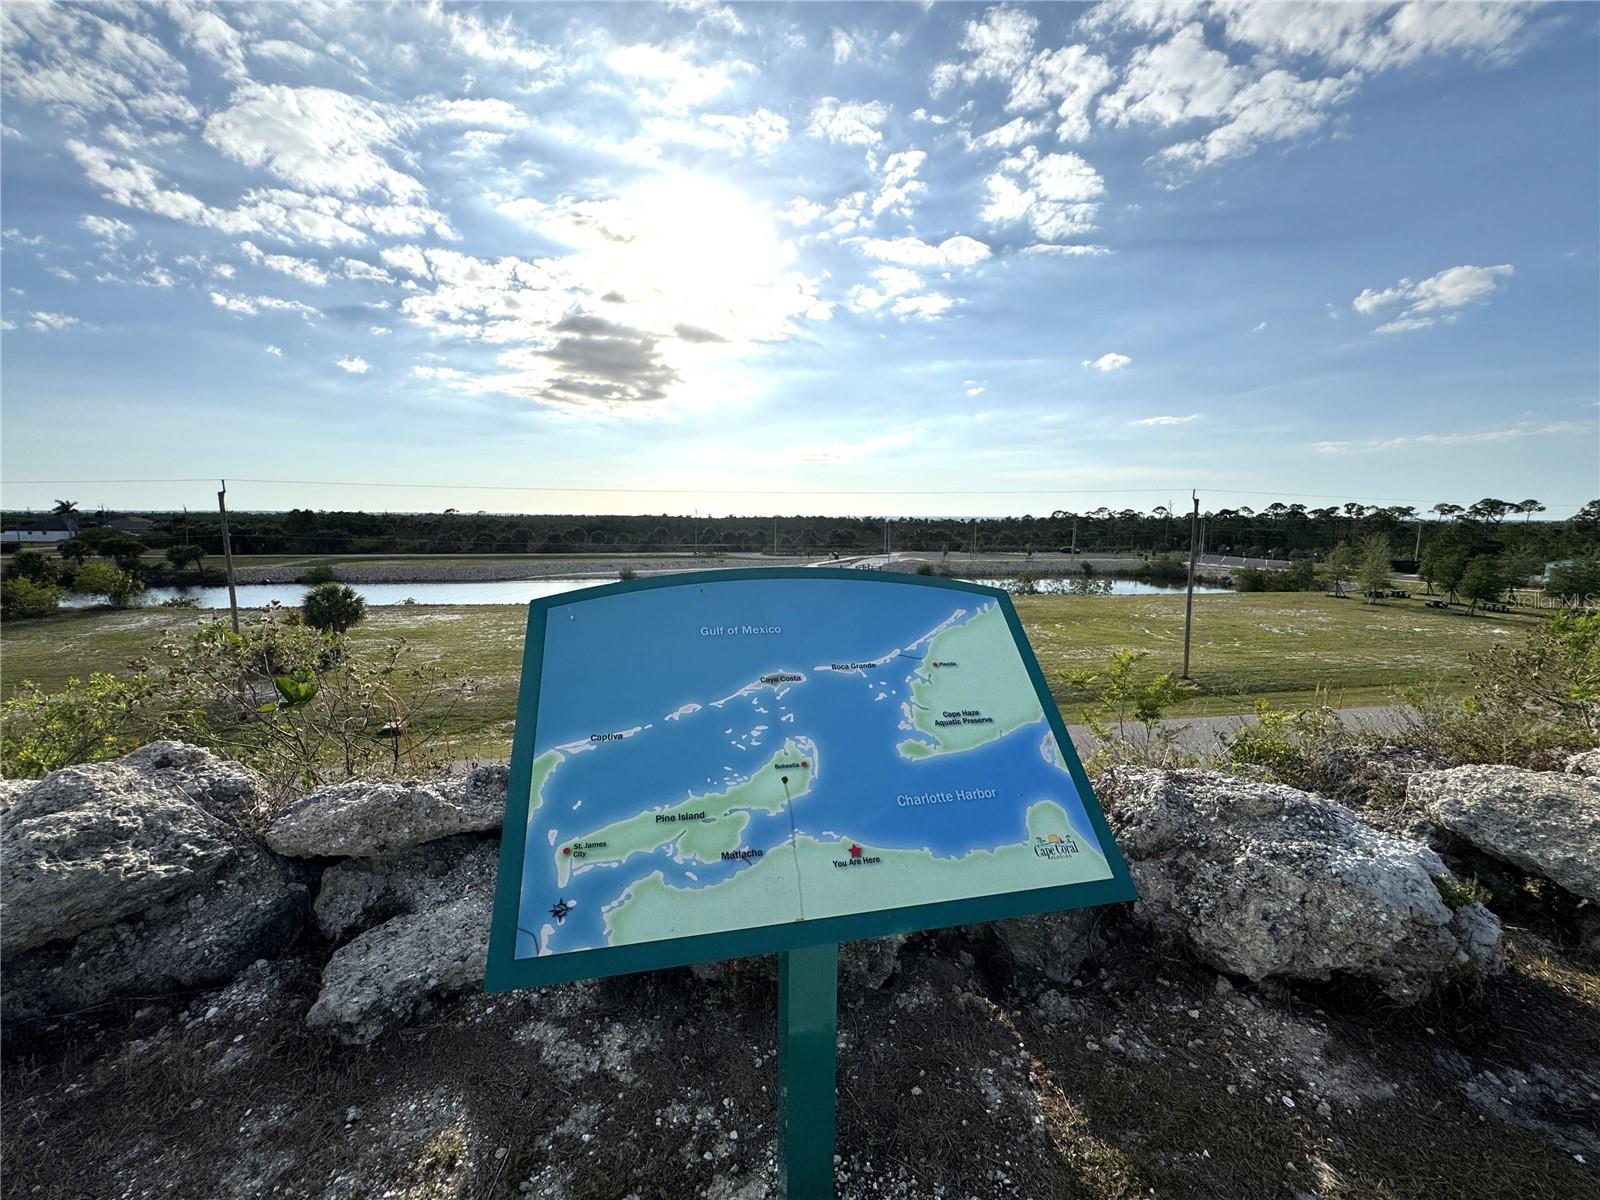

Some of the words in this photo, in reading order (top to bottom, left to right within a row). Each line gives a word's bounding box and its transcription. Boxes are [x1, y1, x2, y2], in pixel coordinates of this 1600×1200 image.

[700, 625, 724, 637] Gulf
[727, 625, 739, 636] of
[742, 625, 782, 636] Mexico
[831, 663, 850, 671] Boca
[850, 662, 876, 671] Grande
[942, 710, 961, 718] Cape
[962, 709, 980, 717] Haze
[934, 719, 961, 728] Aquatic
[962, 717, 993, 726] Preserve
[590, 733, 624, 743] Captiva
[897, 793, 953, 807] Charlotte
[955, 788, 997, 802] Harbor
[655, 814, 676, 823] Pine
[678, 811, 706, 822] Island
[584, 841, 607, 849] James
[721, 849, 764, 861] Matlacha
[832, 860, 848, 868] You
[849, 858, 861, 866] Are
[862, 857, 881, 865] Here
